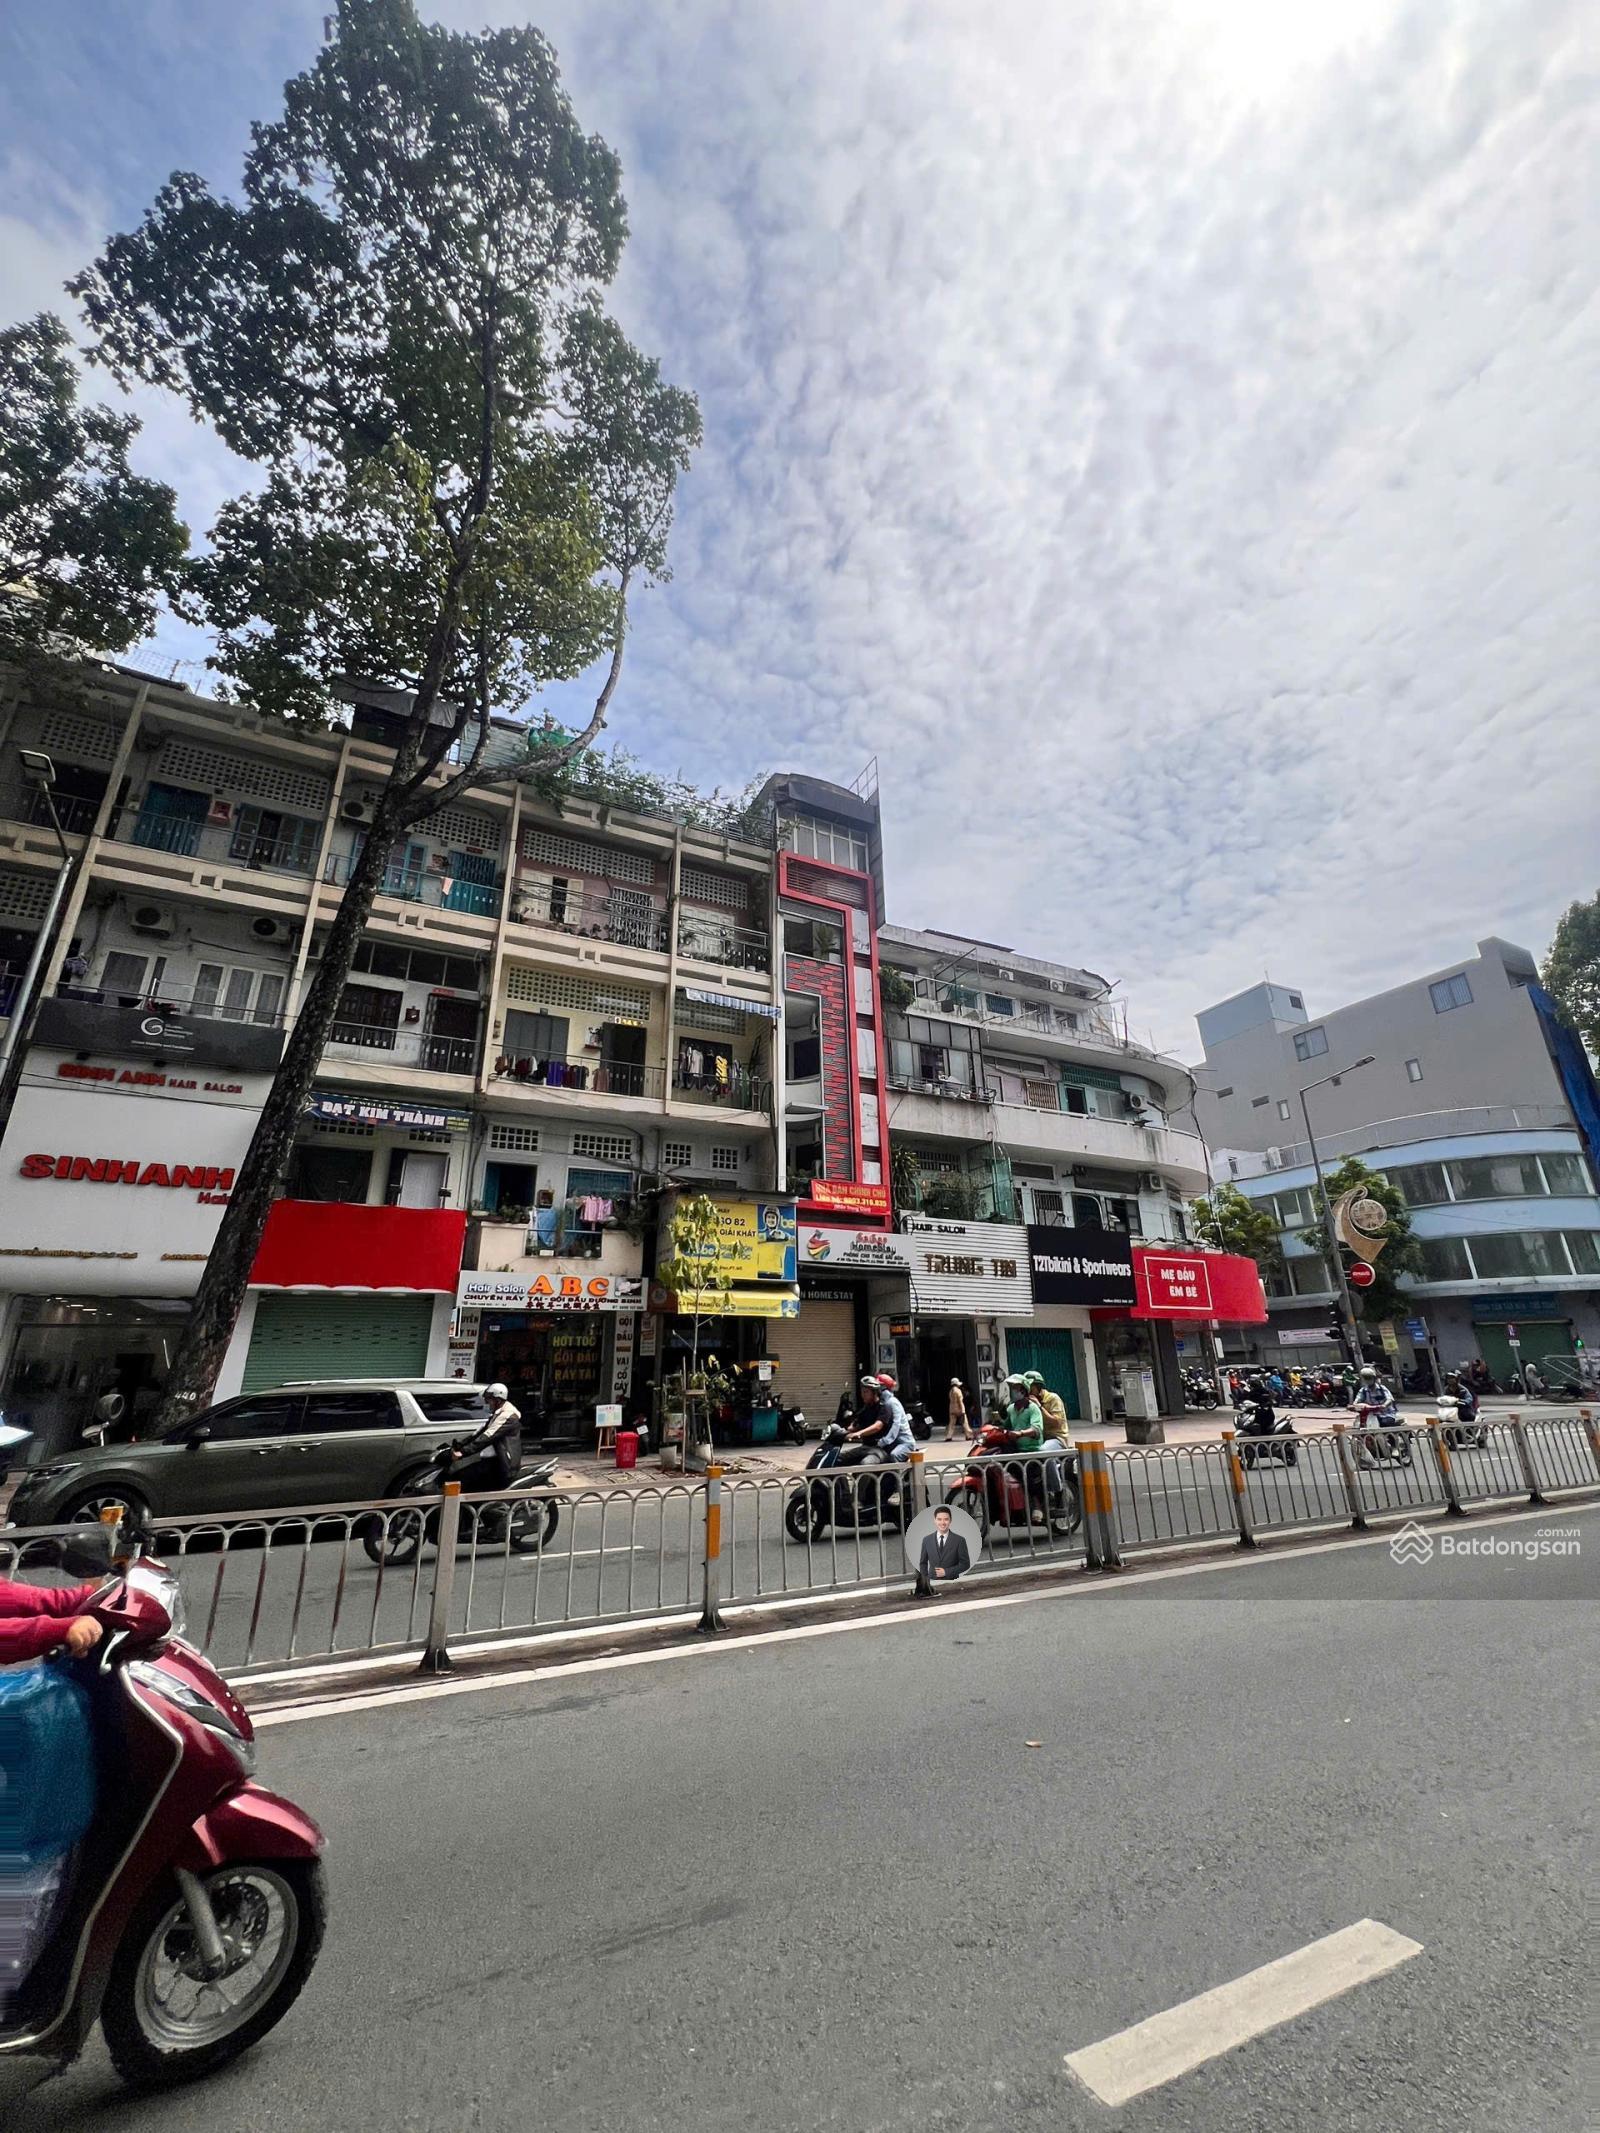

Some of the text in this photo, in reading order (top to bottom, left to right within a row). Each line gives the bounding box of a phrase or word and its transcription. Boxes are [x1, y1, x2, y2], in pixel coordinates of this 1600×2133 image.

[169, 1079, 198, 1089] HAIR
[203, 1082, 243, 1094] SALON
[358, 1106, 389, 1120] KIM
[393, 1110, 446, 1127] THÀNH
[20, 1153, 236, 1190] SINHANH
[734, 1218, 746, 1226] 82
[912, 1223, 966, 1235] HAIR SALON
[925, 1253, 984, 1276] TRUNG
[1073, 1257, 1081, 1274] &
[1082, 1258, 1132, 1277] Sportwears
[1160, 1268, 1175, 1282] MẸ
[467, 1283, 526, 1294] Hair Salon
[1169, 1285, 1198, 1298] EM BÉ
[527, 1295, 543, 1303] TAI
[807, 1291, 854, 1300] HOMESTAY
[461, 1314, 479, 1323] UYÊN
[617, 1357, 630, 1366] VAI
